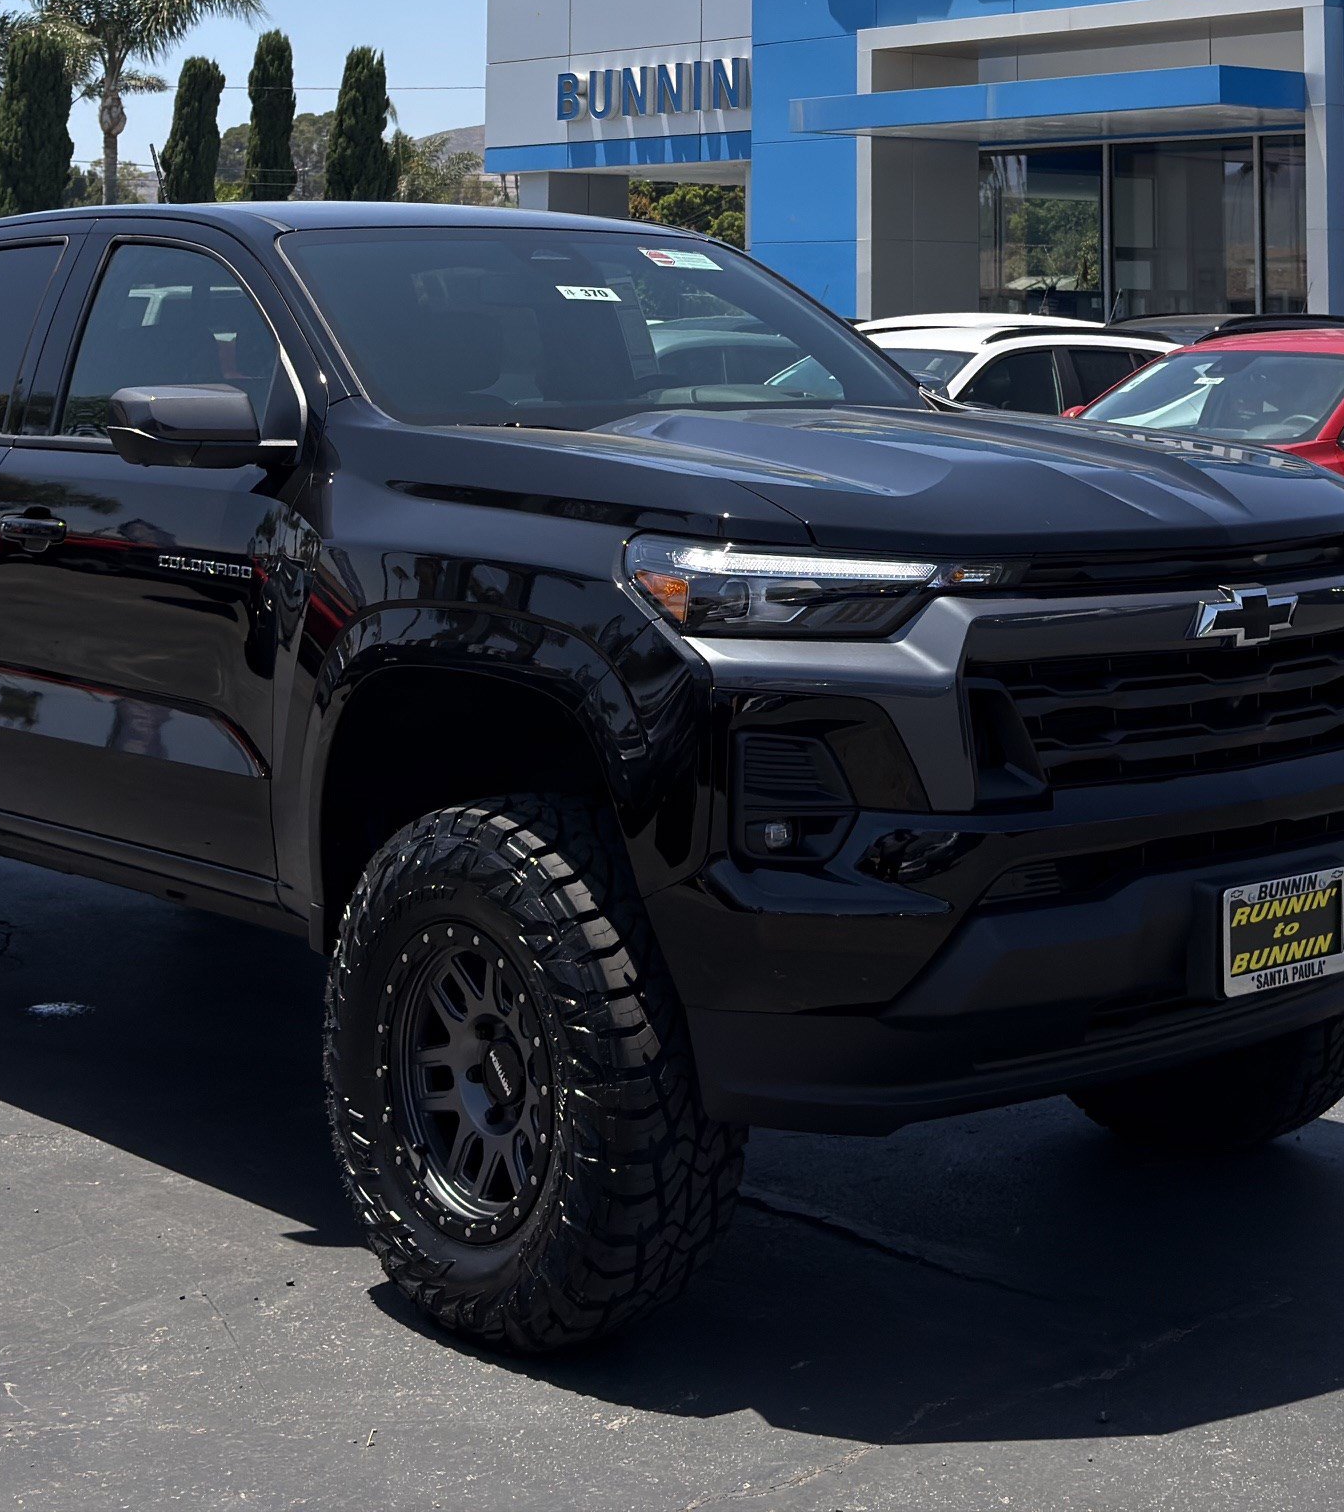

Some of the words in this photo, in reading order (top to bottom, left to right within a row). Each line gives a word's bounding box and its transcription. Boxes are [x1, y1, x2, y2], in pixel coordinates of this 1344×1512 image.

[556, 57, 751, 121] BUNNIN
[158, 554, 252, 579] COLORADO
[1257, 874, 1318, 901] BUNNIN
[1231, 887, 1337, 928] RUNNIN'
[1273, 922, 1300, 938] to
[1231, 933, 1333, 975] BUNNIN
